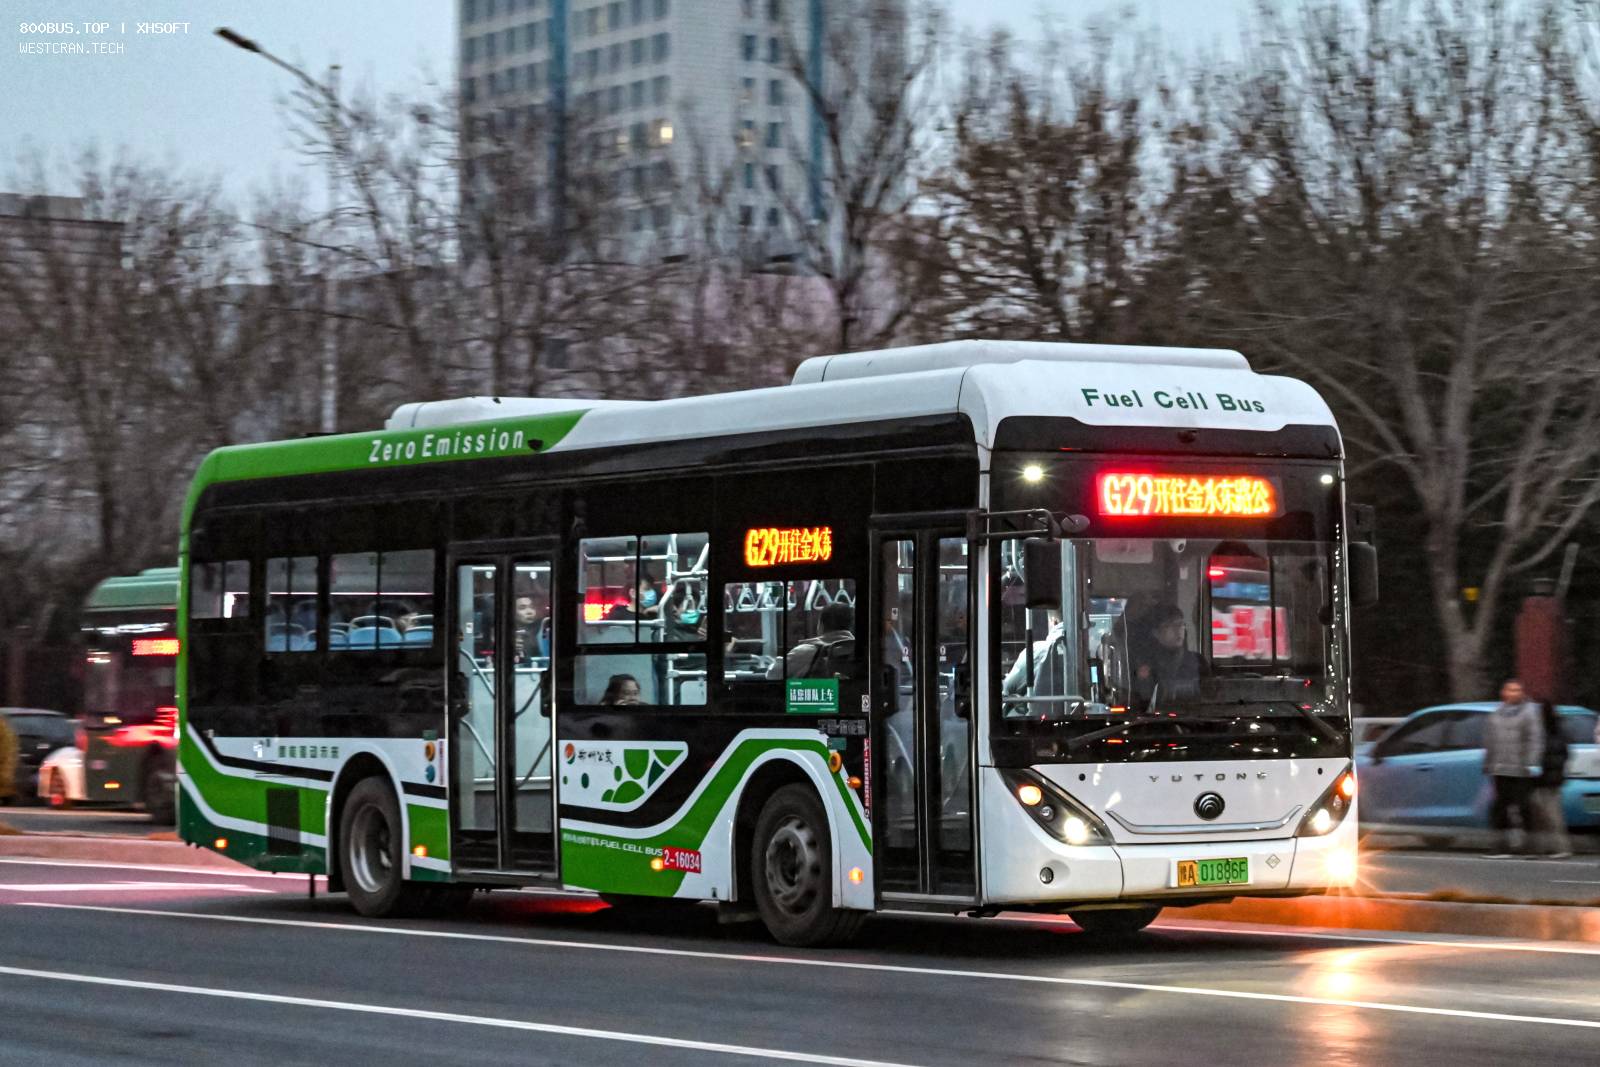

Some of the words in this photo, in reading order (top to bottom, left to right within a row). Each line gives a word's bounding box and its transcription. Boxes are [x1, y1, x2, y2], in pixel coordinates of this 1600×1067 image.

[1081, 388, 1143, 408] Fuel
[1153, 390, 1209, 410] Cell
[1216, 393, 1265, 413] Bus
[368, 439, 416, 463] Zero
[421, 428, 524, 457] Emission
[600, 839, 621, 850] FUEL
[622, 842, 644, 853] CELL
[645, 846, 663, 857] BUS
[664, 849, 700, 870] 2-16034
[1201, 861, 1246, 882] 01886F
